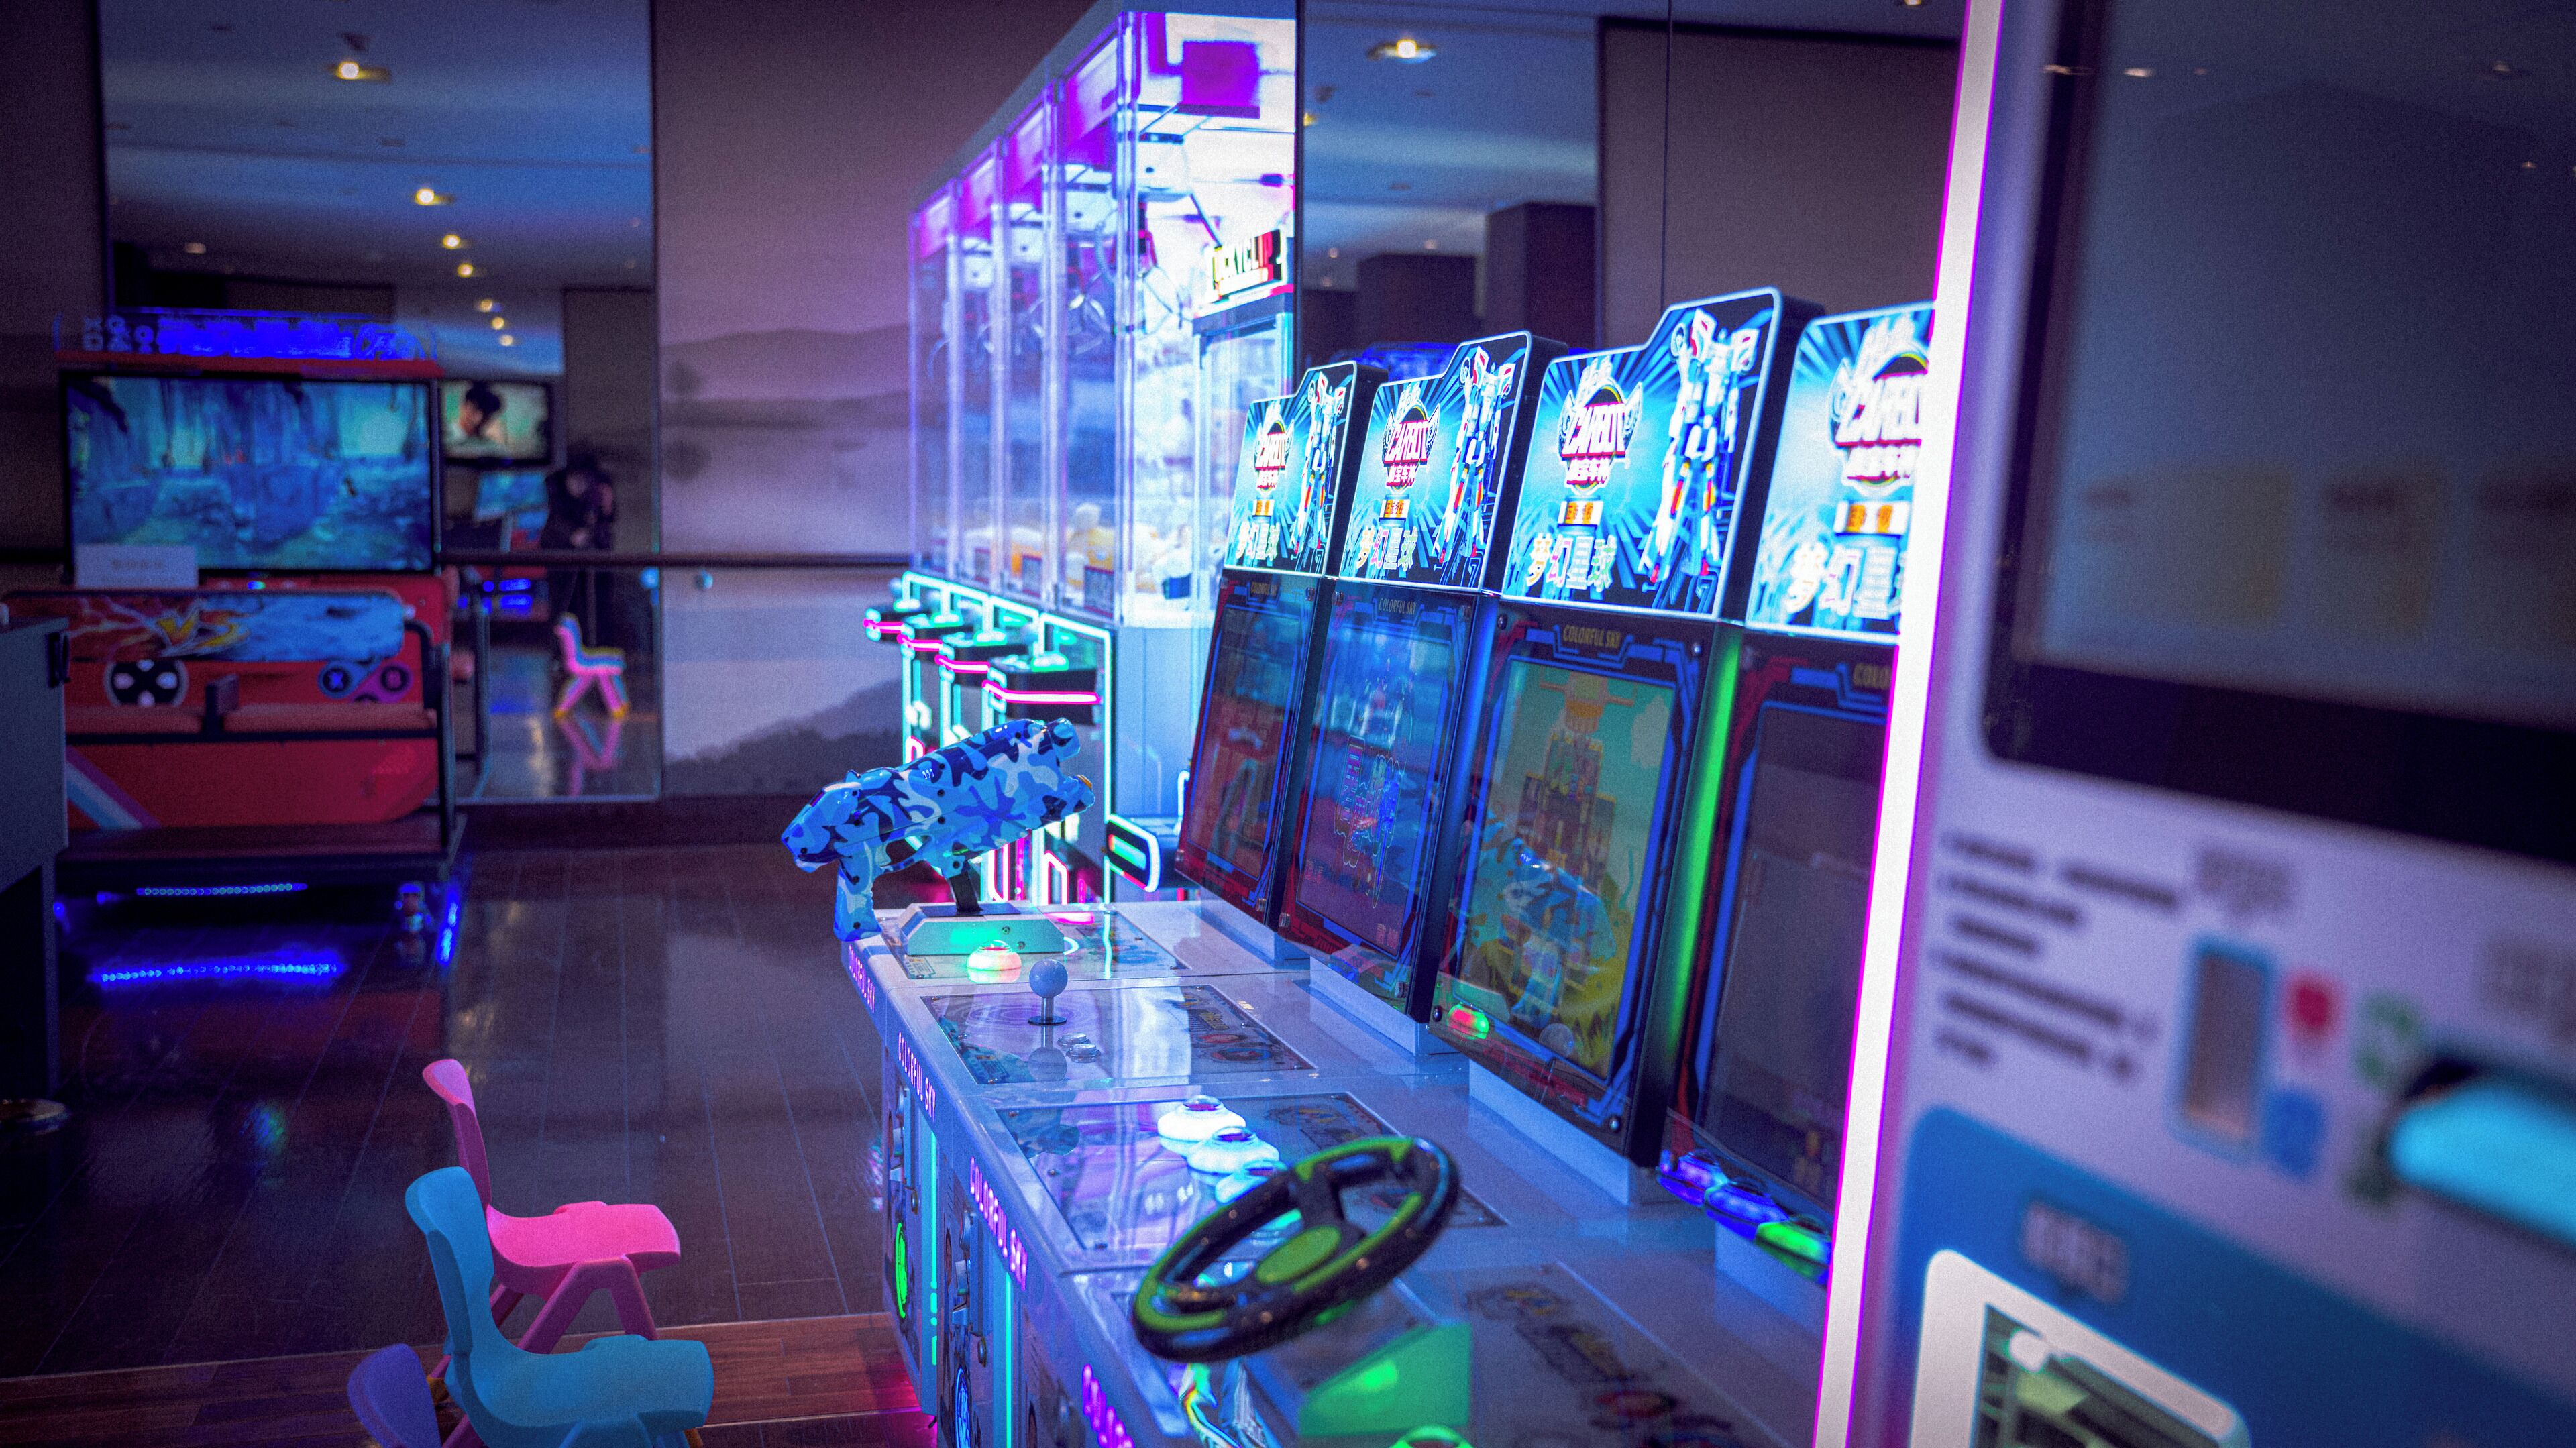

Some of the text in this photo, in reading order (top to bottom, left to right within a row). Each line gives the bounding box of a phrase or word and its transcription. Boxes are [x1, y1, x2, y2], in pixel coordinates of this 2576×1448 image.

[1384, 421, 1429, 463] CARBOT
[1356, 526, 1417, 571] 梦幻星球
[1526, 534, 1617, 592] 梦幻星球
[1379, 598, 1417, 615] COLORFUL SKY
[1563, 624, 1605, 646] COLORFUL
[898, 1030, 936, 1123] COLORFUL SKY
[970, 1156, 1008, 1258] COLORFUL
